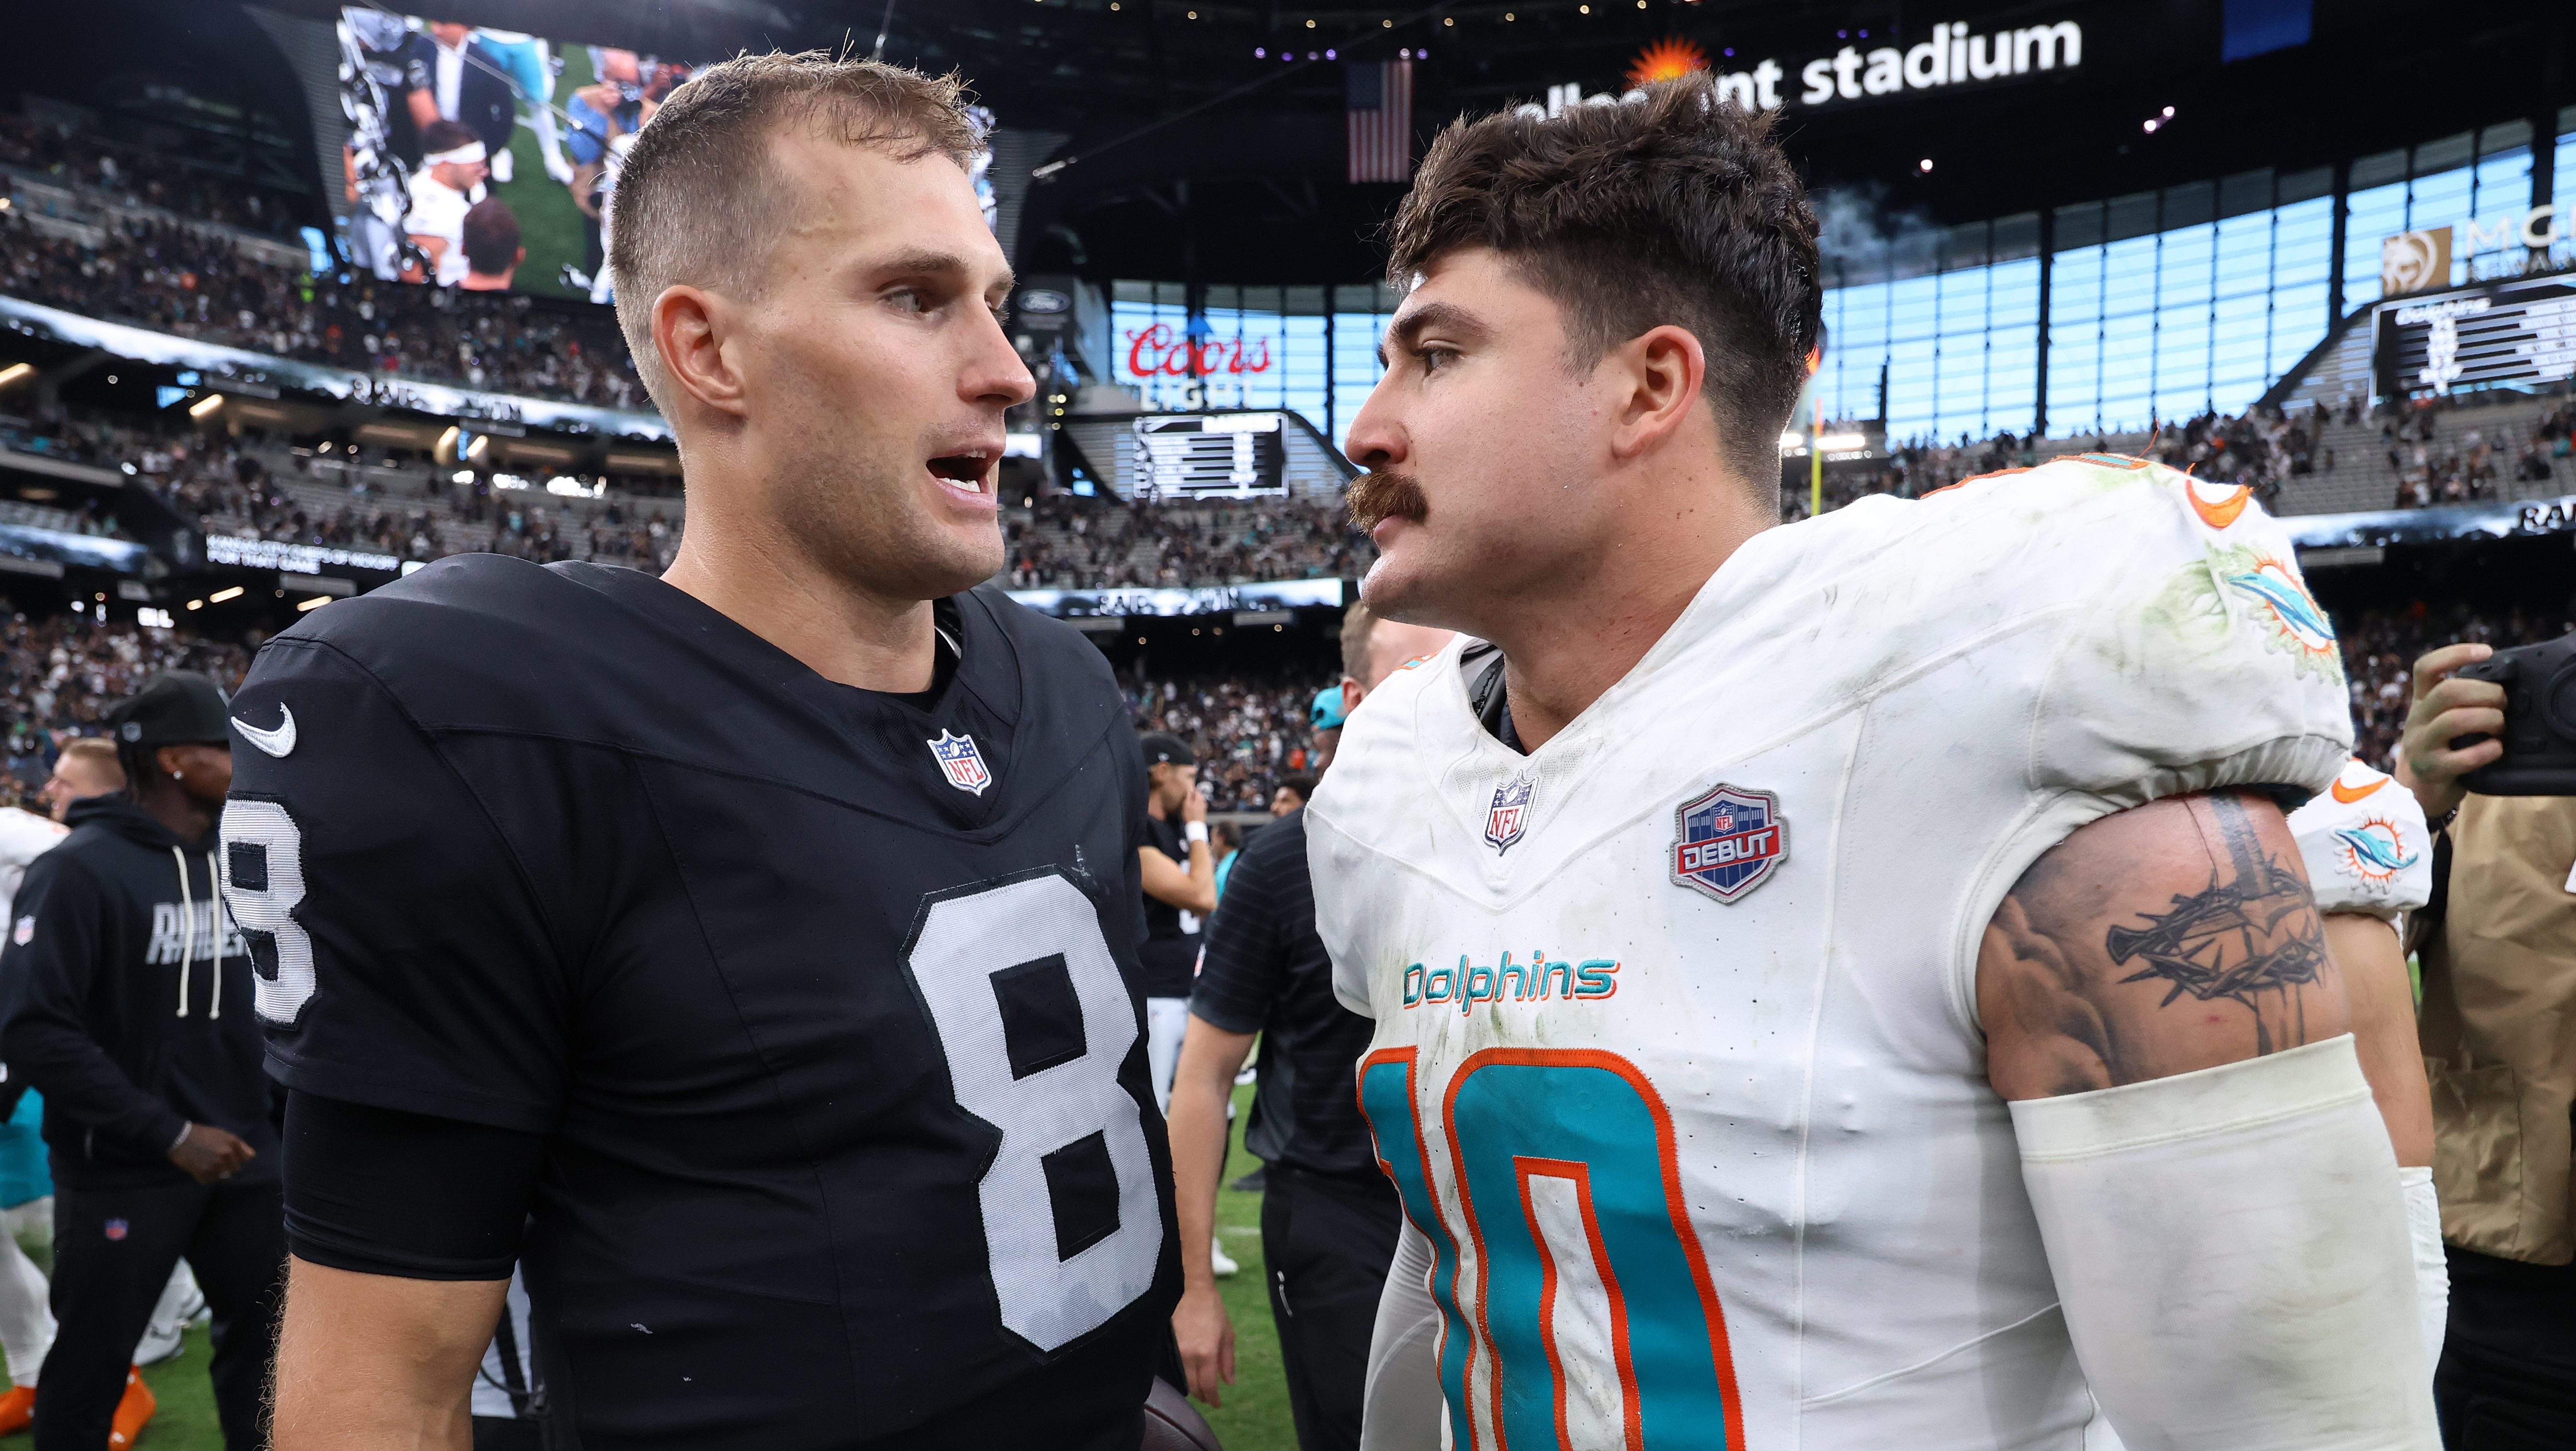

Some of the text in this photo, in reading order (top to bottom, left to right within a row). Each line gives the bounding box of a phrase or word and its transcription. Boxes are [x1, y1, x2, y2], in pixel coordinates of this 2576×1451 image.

[1801, 21, 2082, 105] stadium
[2465, 203, 2576, 258] MG
[1125, 323, 1272, 377] Coors
[947, 759, 984, 784] NFL
[1489, 808, 1519, 839] NFL
[1715, 815, 1733, 830] NFL
[1682, 830, 1773, 870] DEBUT
[1403, 950, 1620, 1017] Dolphins
[908, 874, 1164, 1352] 8
[1356, 1046, 1747, 1451] 10
